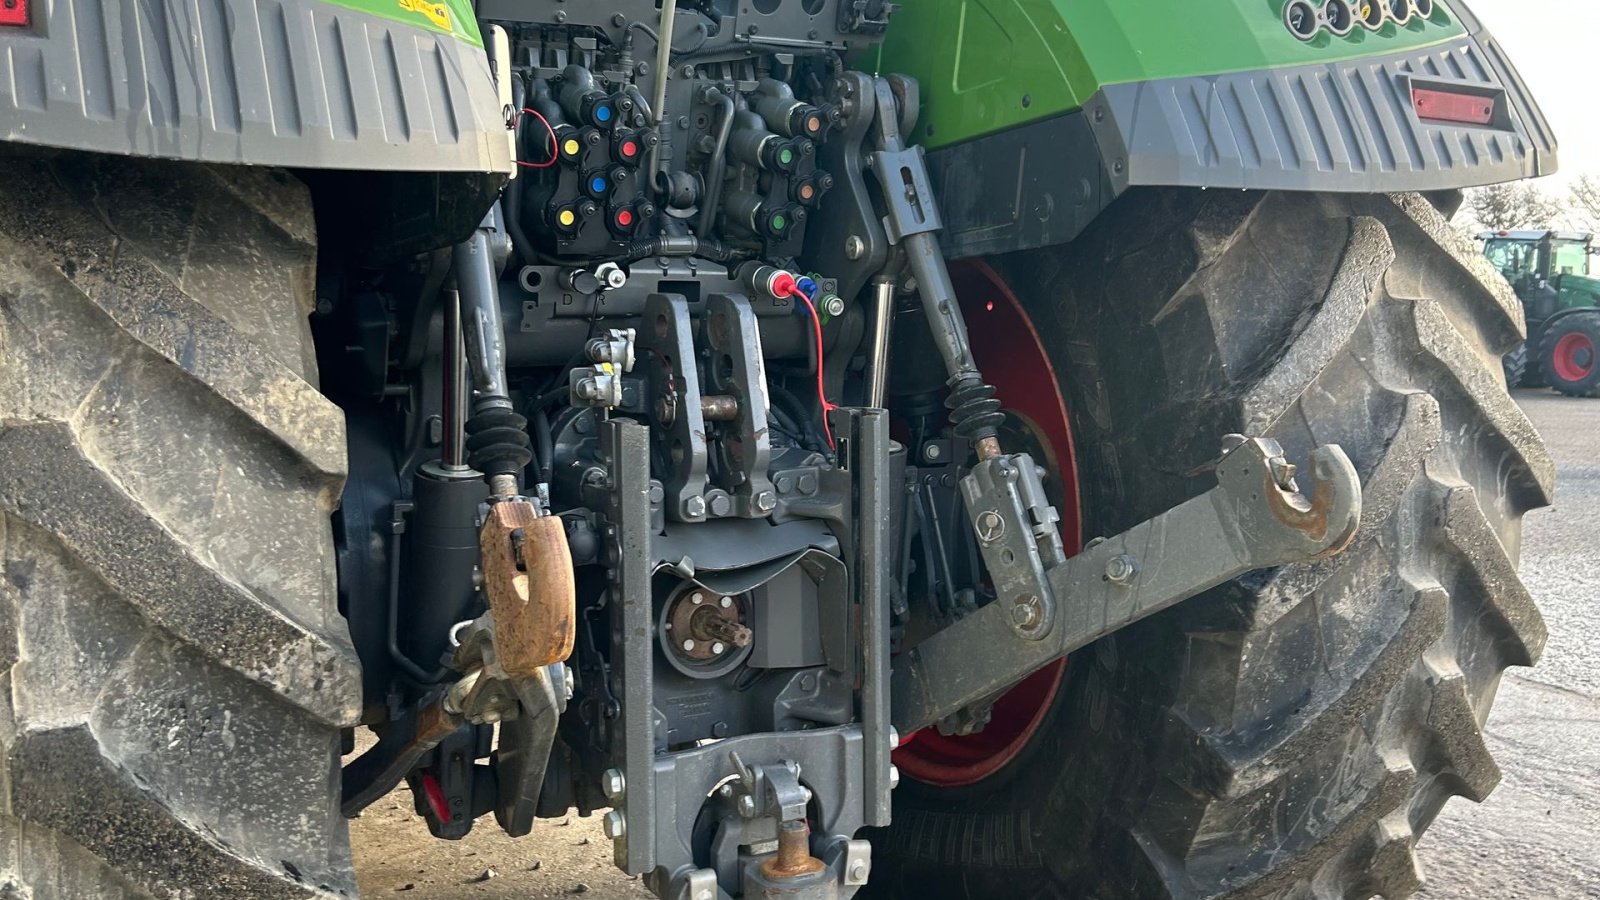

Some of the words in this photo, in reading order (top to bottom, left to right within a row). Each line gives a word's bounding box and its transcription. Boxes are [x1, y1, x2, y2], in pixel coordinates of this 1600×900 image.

[562, 293, 573, 306] D
[598, 293, 606, 306] R
[772, 297, 789, 307] LS
